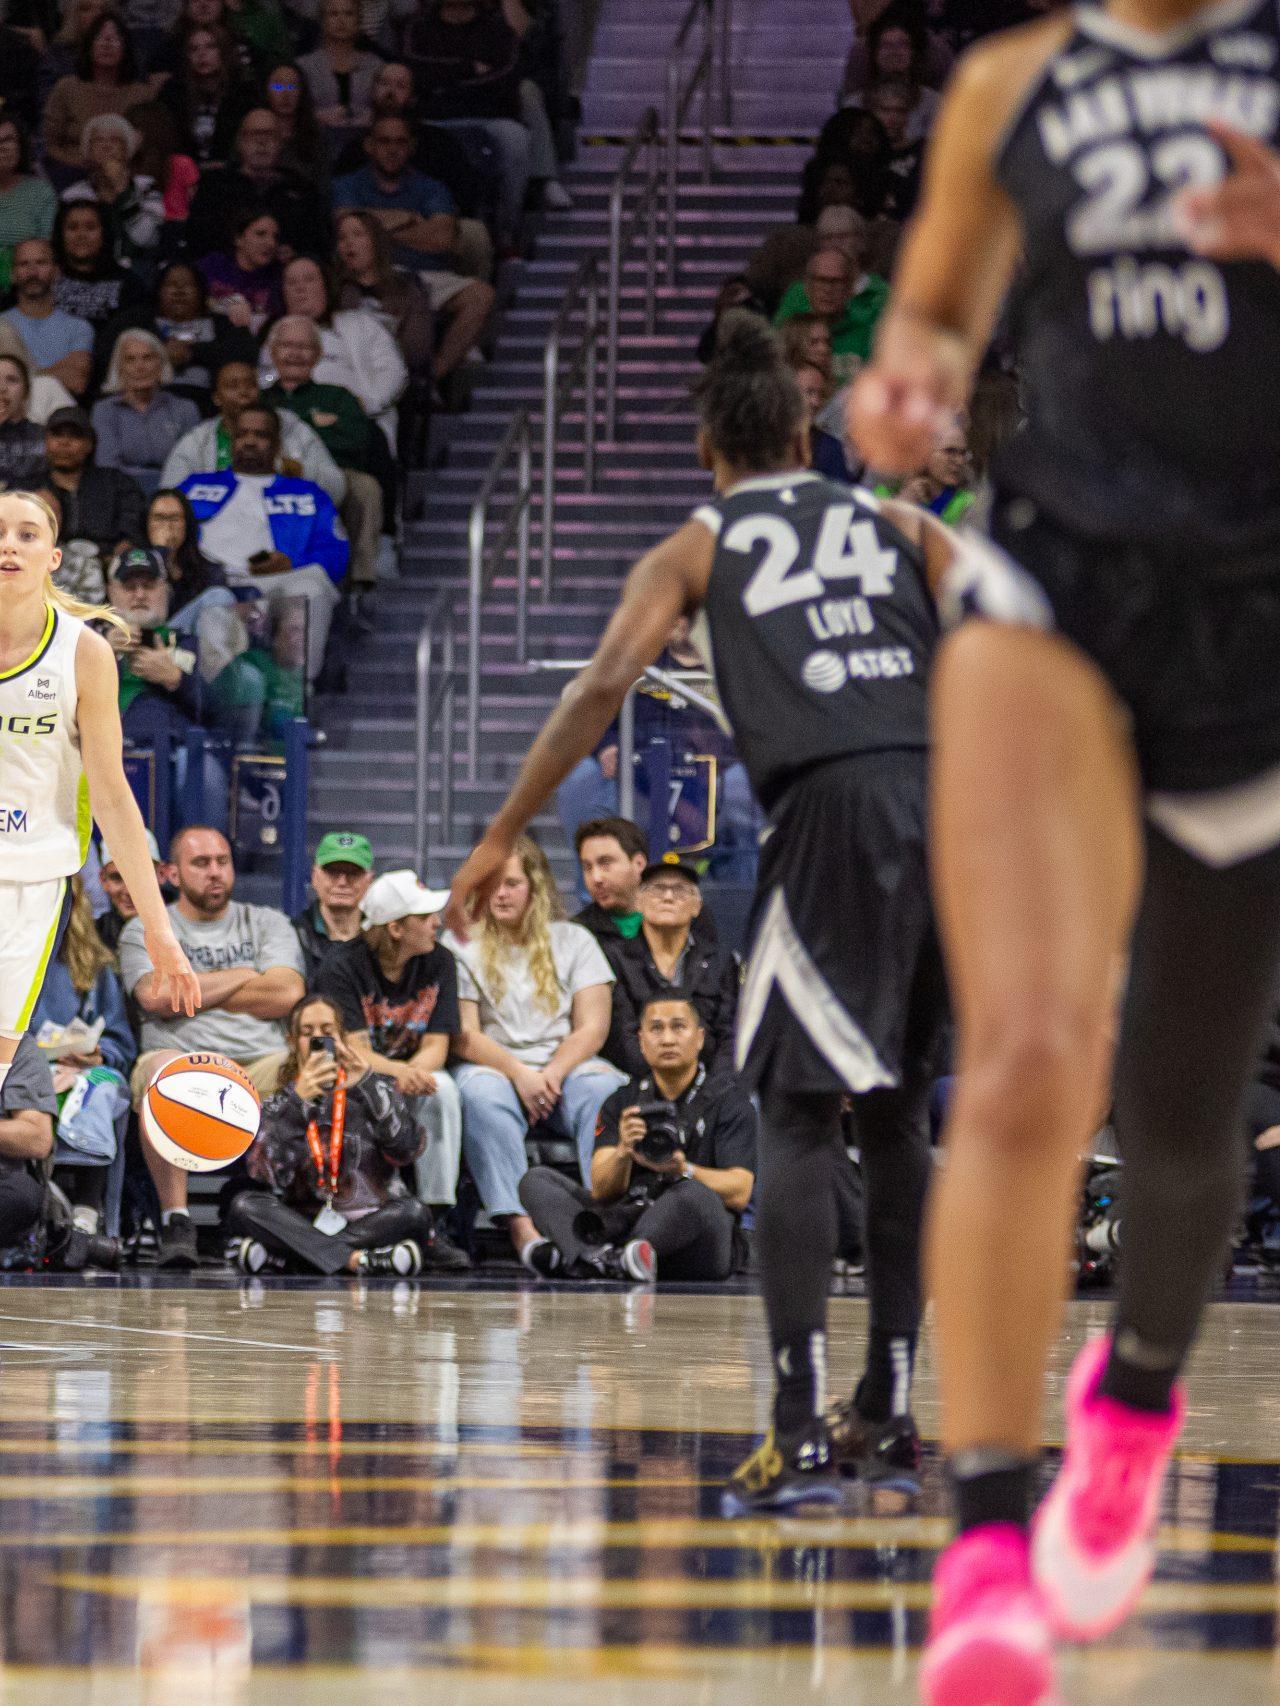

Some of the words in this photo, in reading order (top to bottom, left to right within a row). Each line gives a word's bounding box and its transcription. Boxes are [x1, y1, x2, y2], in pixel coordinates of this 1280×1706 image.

[1067, 137, 1227, 255] 22
[1086, 256, 1231, 352] ring
[723, 503, 898, 618] 24
[805, 597, 875, 641] LOYD
[847, 646, 914, 678] AT&T
[28, 689, 57, 701] Albert
[668, 780, 684, 817] 7
